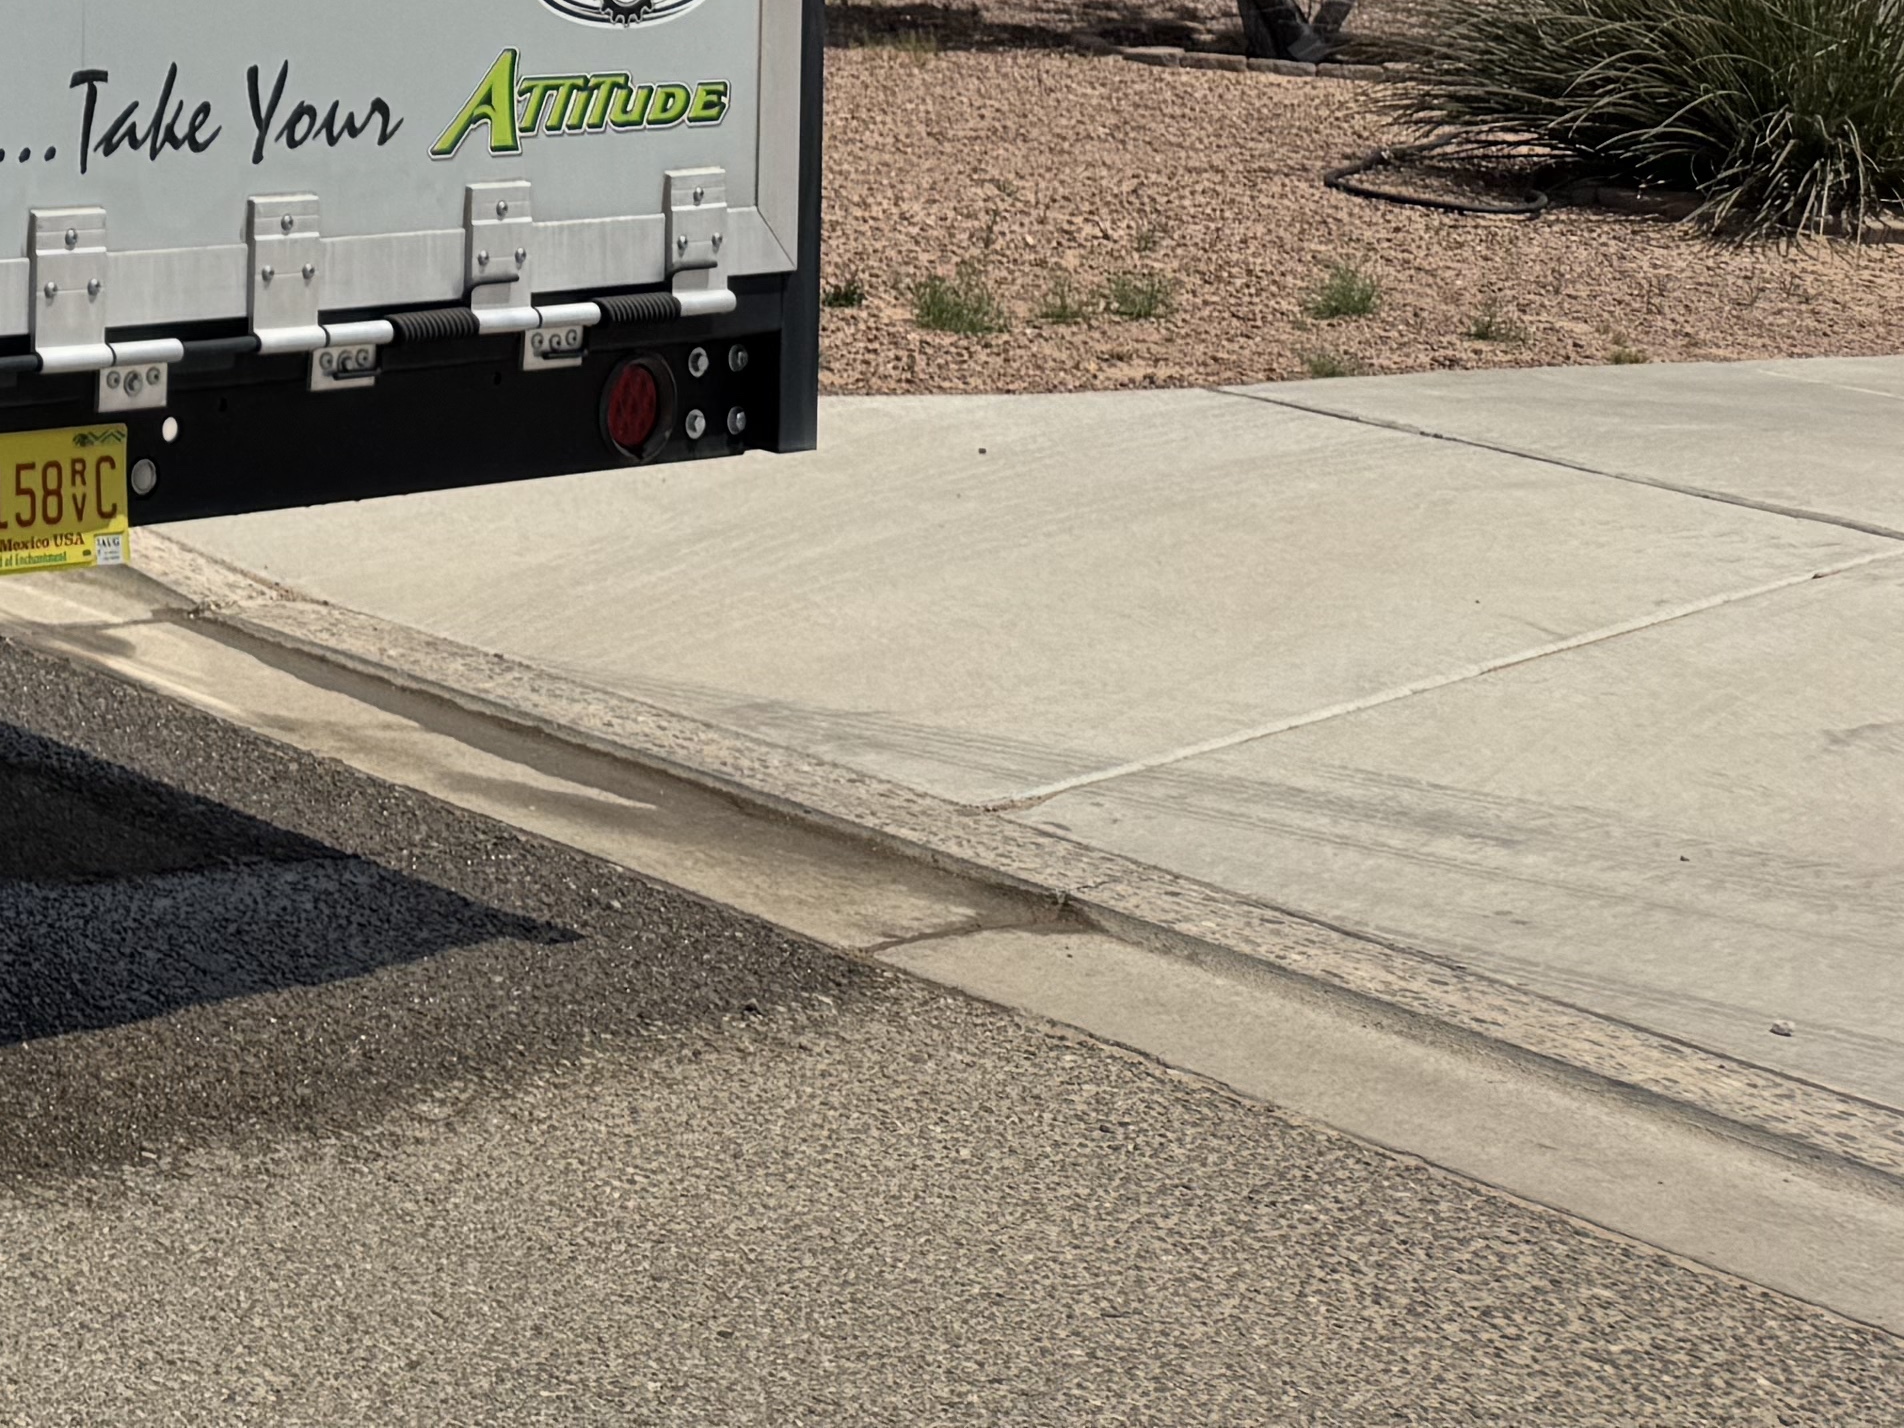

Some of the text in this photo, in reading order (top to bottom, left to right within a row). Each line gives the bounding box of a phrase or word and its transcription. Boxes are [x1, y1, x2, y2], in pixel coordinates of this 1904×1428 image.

[246, 59, 405, 164] Your
[427, 47, 732, 161] ATTITUDE
[53, 531, 85, 547] USA
